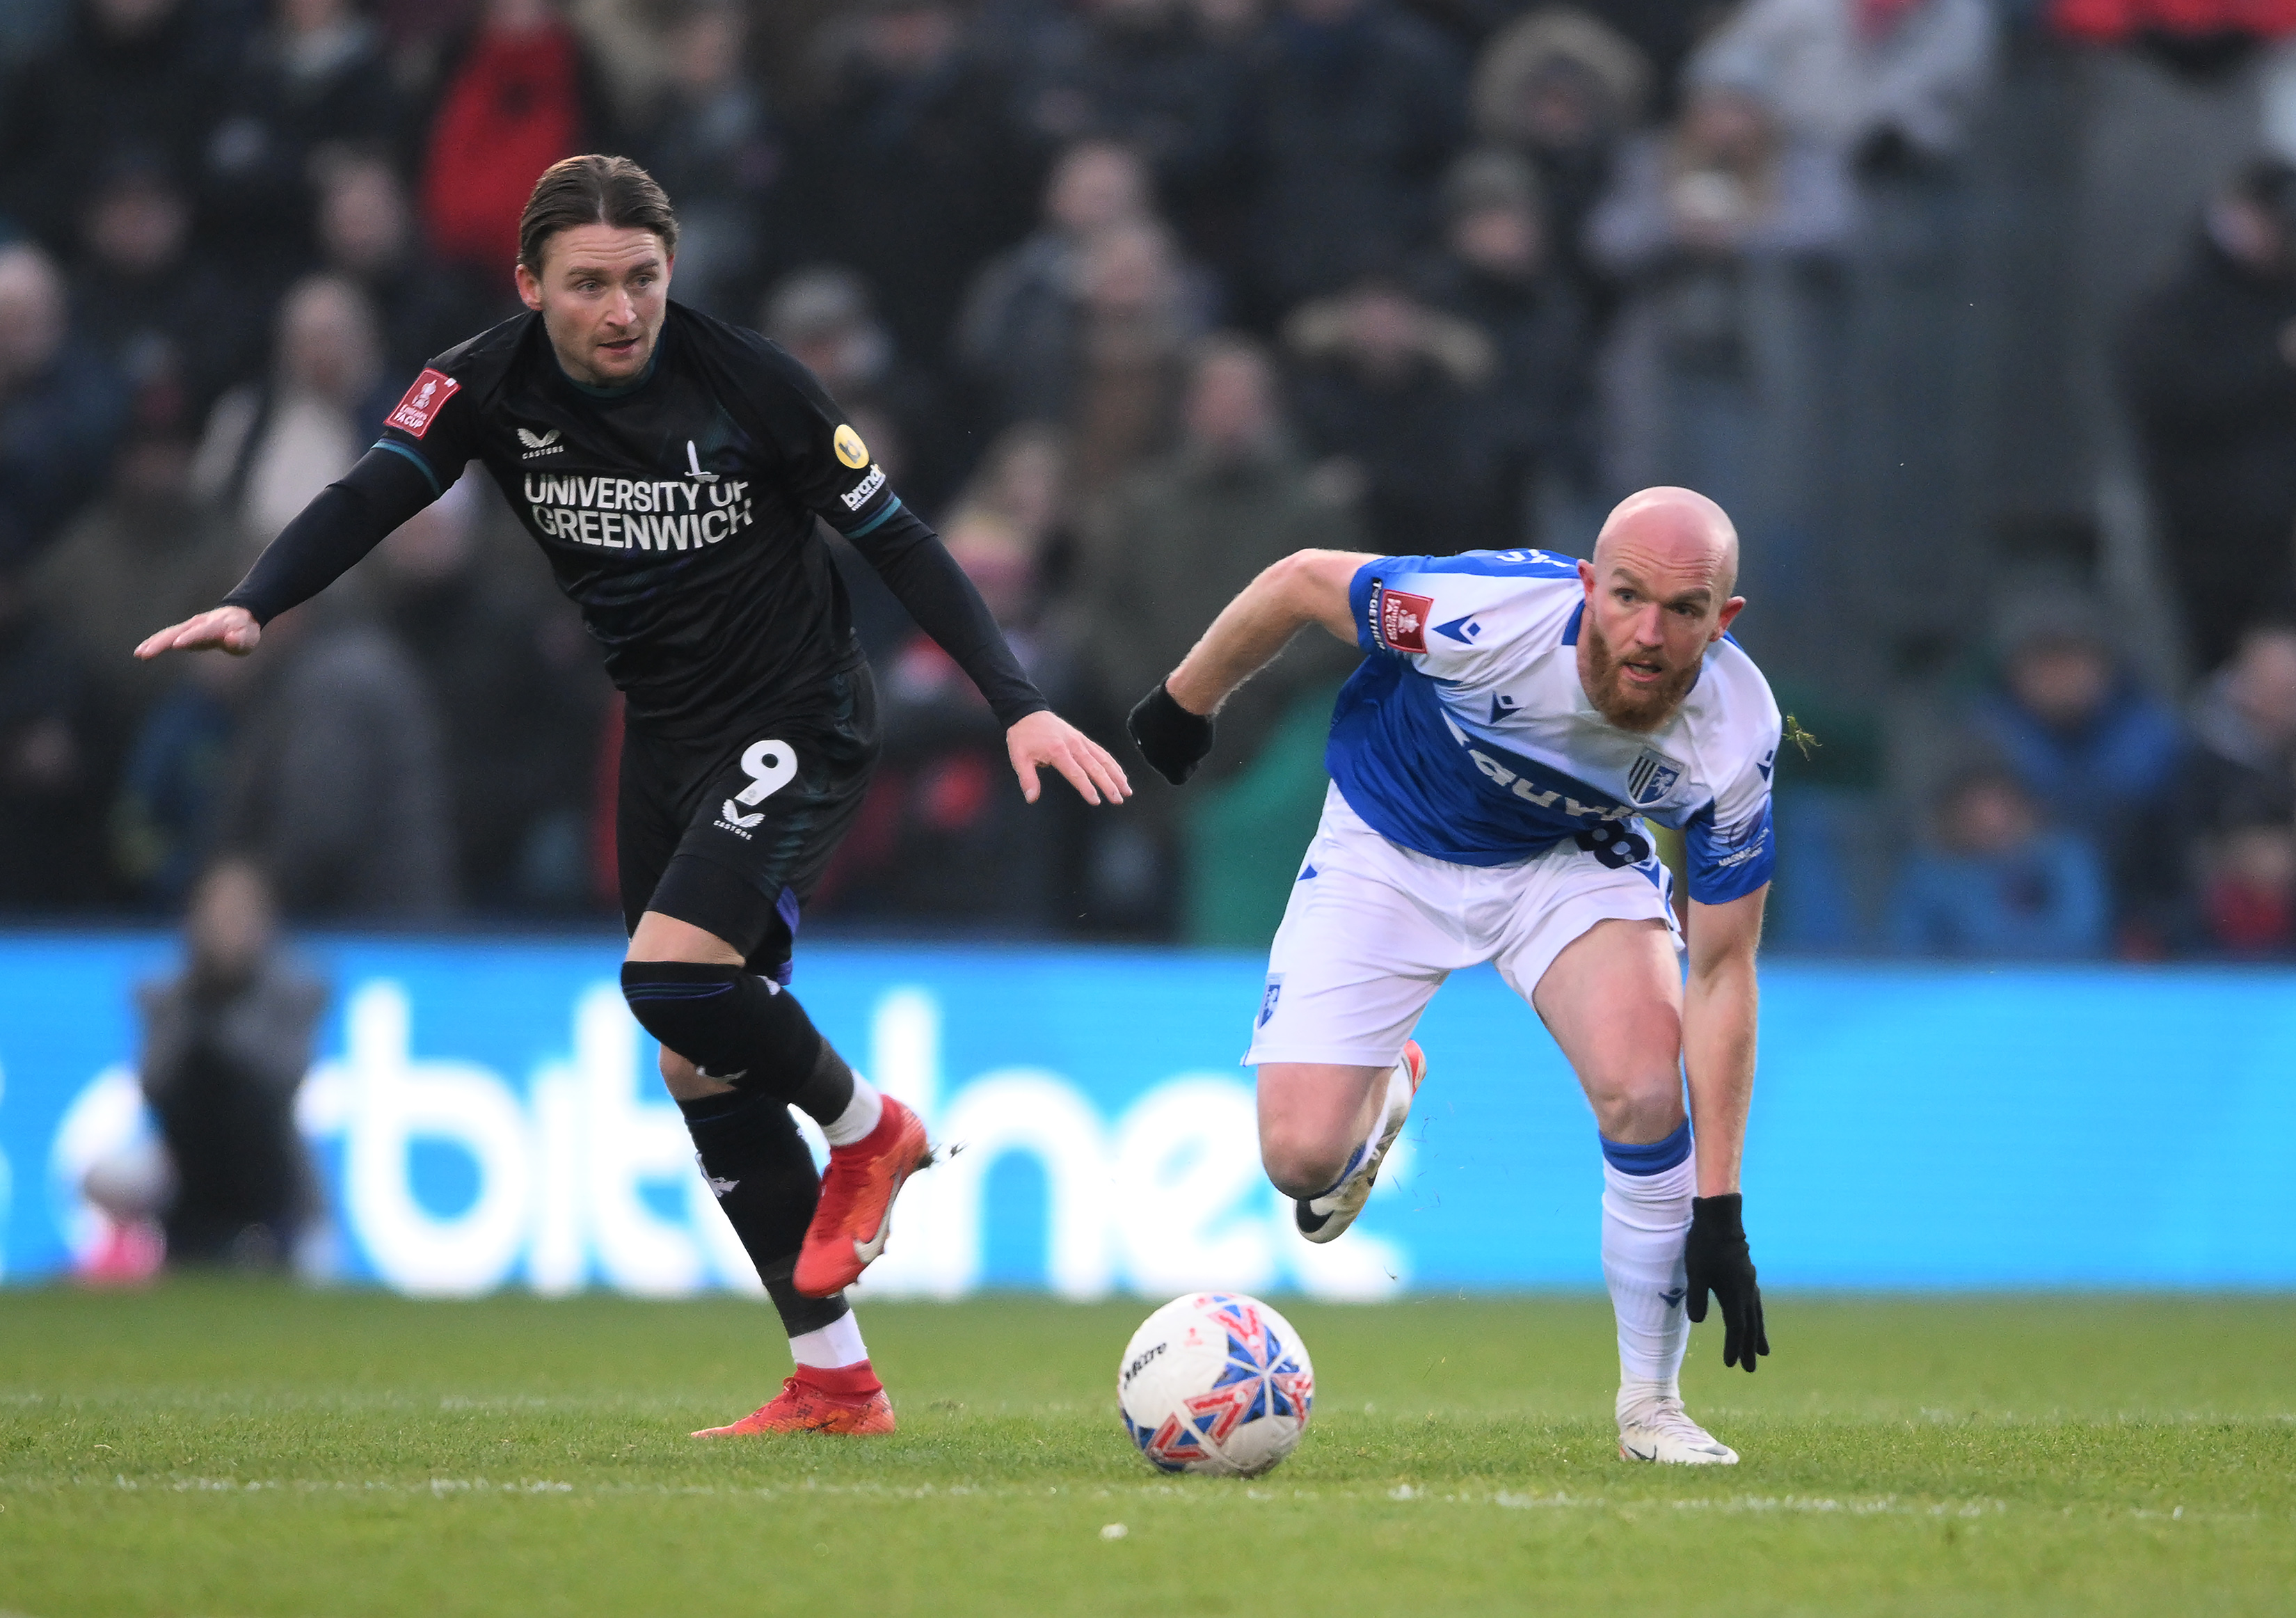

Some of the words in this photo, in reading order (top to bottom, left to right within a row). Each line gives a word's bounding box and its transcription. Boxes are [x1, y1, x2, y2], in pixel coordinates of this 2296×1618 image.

[521, 445, 565, 461] CASTORE
[523, 472, 701, 513] UNIVERSITY
[711, 479, 749, 510] OF
[533, 497, 754, 550] GREENWICH
[734, 739, 798, 807] 9
[712, 820, 754, 841] CASTORE
[1574, 819, 1650, 869] 8
